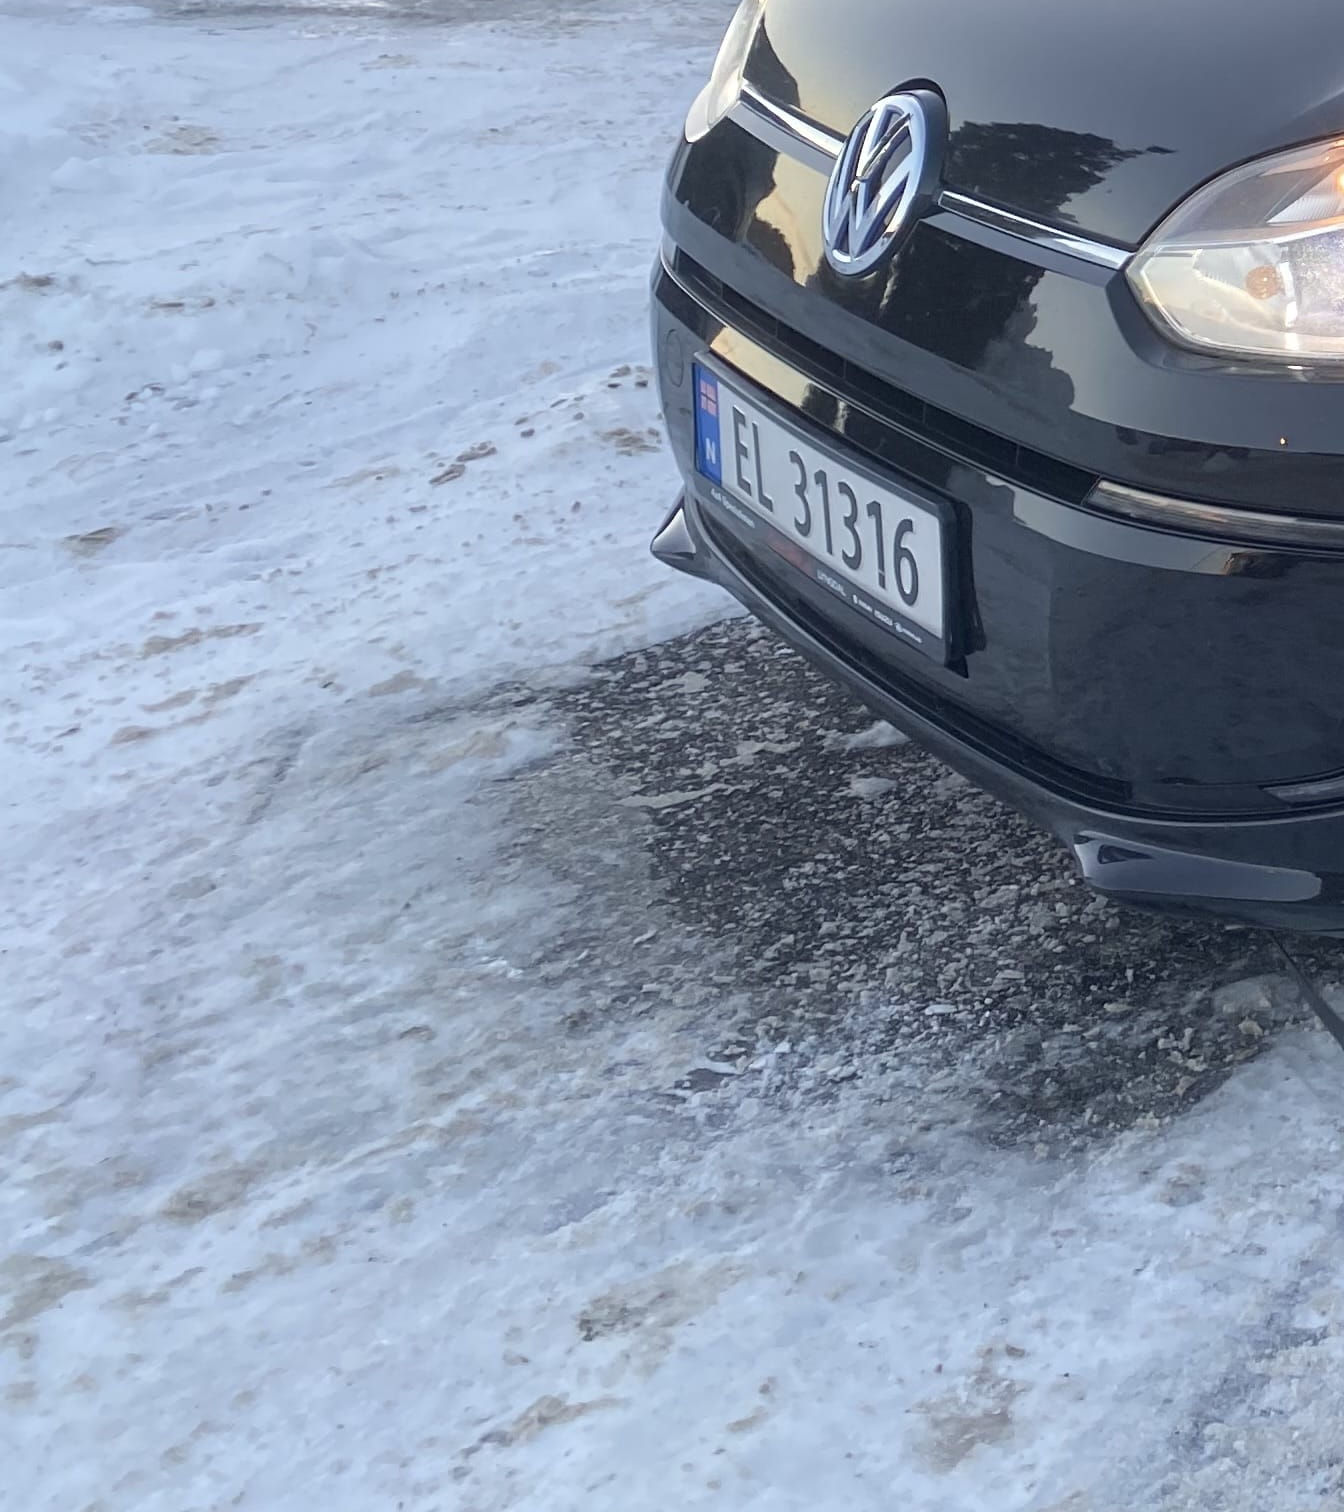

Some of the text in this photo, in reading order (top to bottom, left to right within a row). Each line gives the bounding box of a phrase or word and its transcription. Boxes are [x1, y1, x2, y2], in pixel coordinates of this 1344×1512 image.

[705, 437, 717, 465] N
[732, 404, 920, 607] EL 31316
